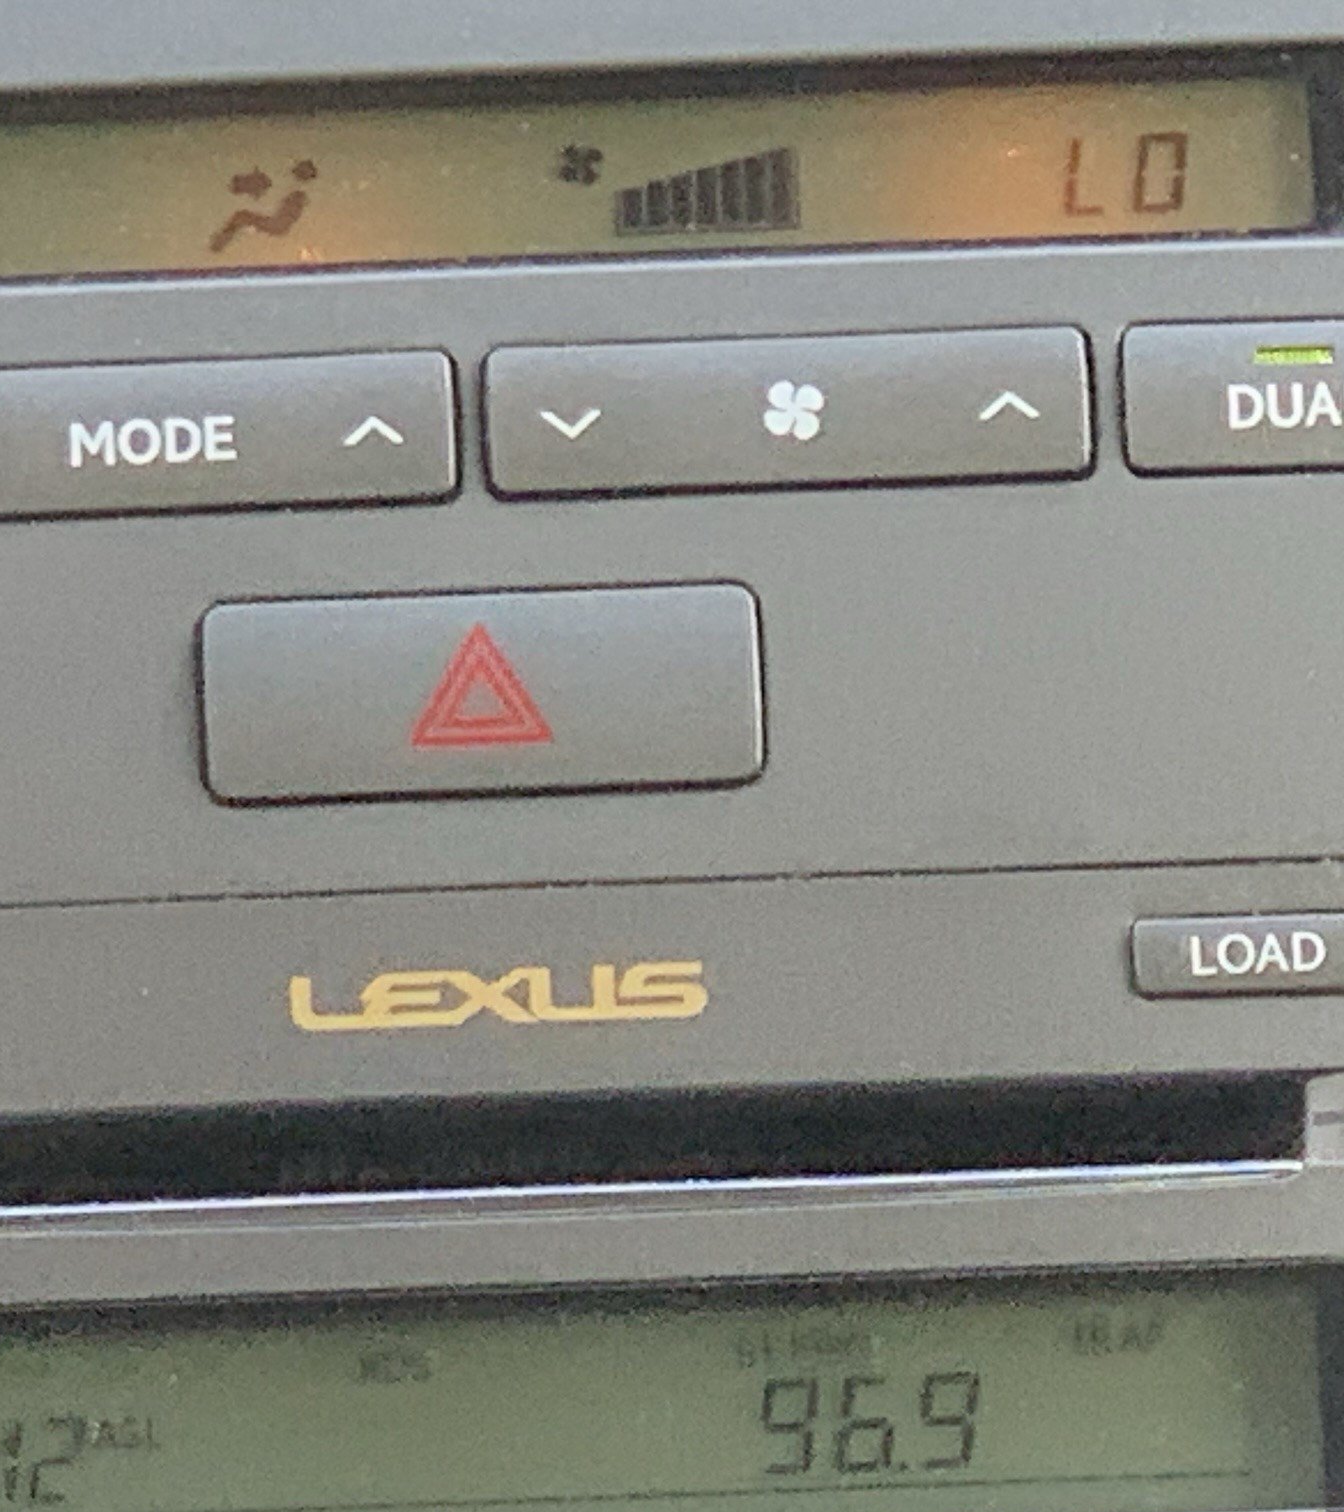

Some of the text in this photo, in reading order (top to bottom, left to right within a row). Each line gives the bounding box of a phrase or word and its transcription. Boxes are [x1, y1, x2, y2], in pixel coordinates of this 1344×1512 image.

[69, 415, 237, 468] MODE
[1190, 931, 1326, 976] LOAD
[289, 961, 706, 1030] LEXUS
[760, 1371, 980, 1475] 96.9
